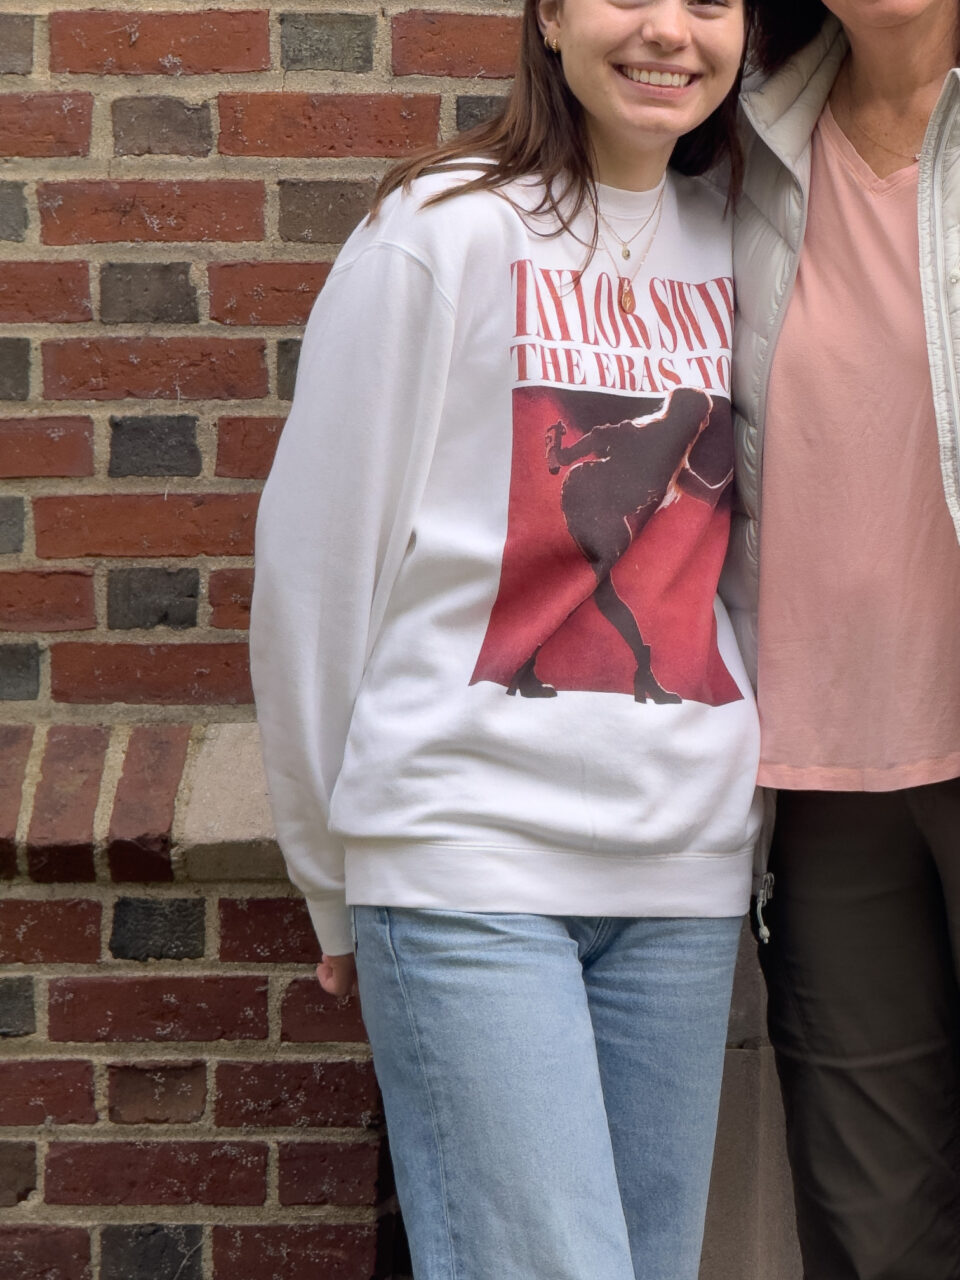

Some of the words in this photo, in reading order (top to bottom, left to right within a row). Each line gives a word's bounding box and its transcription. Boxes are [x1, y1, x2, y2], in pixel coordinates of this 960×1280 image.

[510, 259, 652, 350] TAYLOR
[510, 343, 587, 385] THE
[593, 351, 682, 393] ERAS
